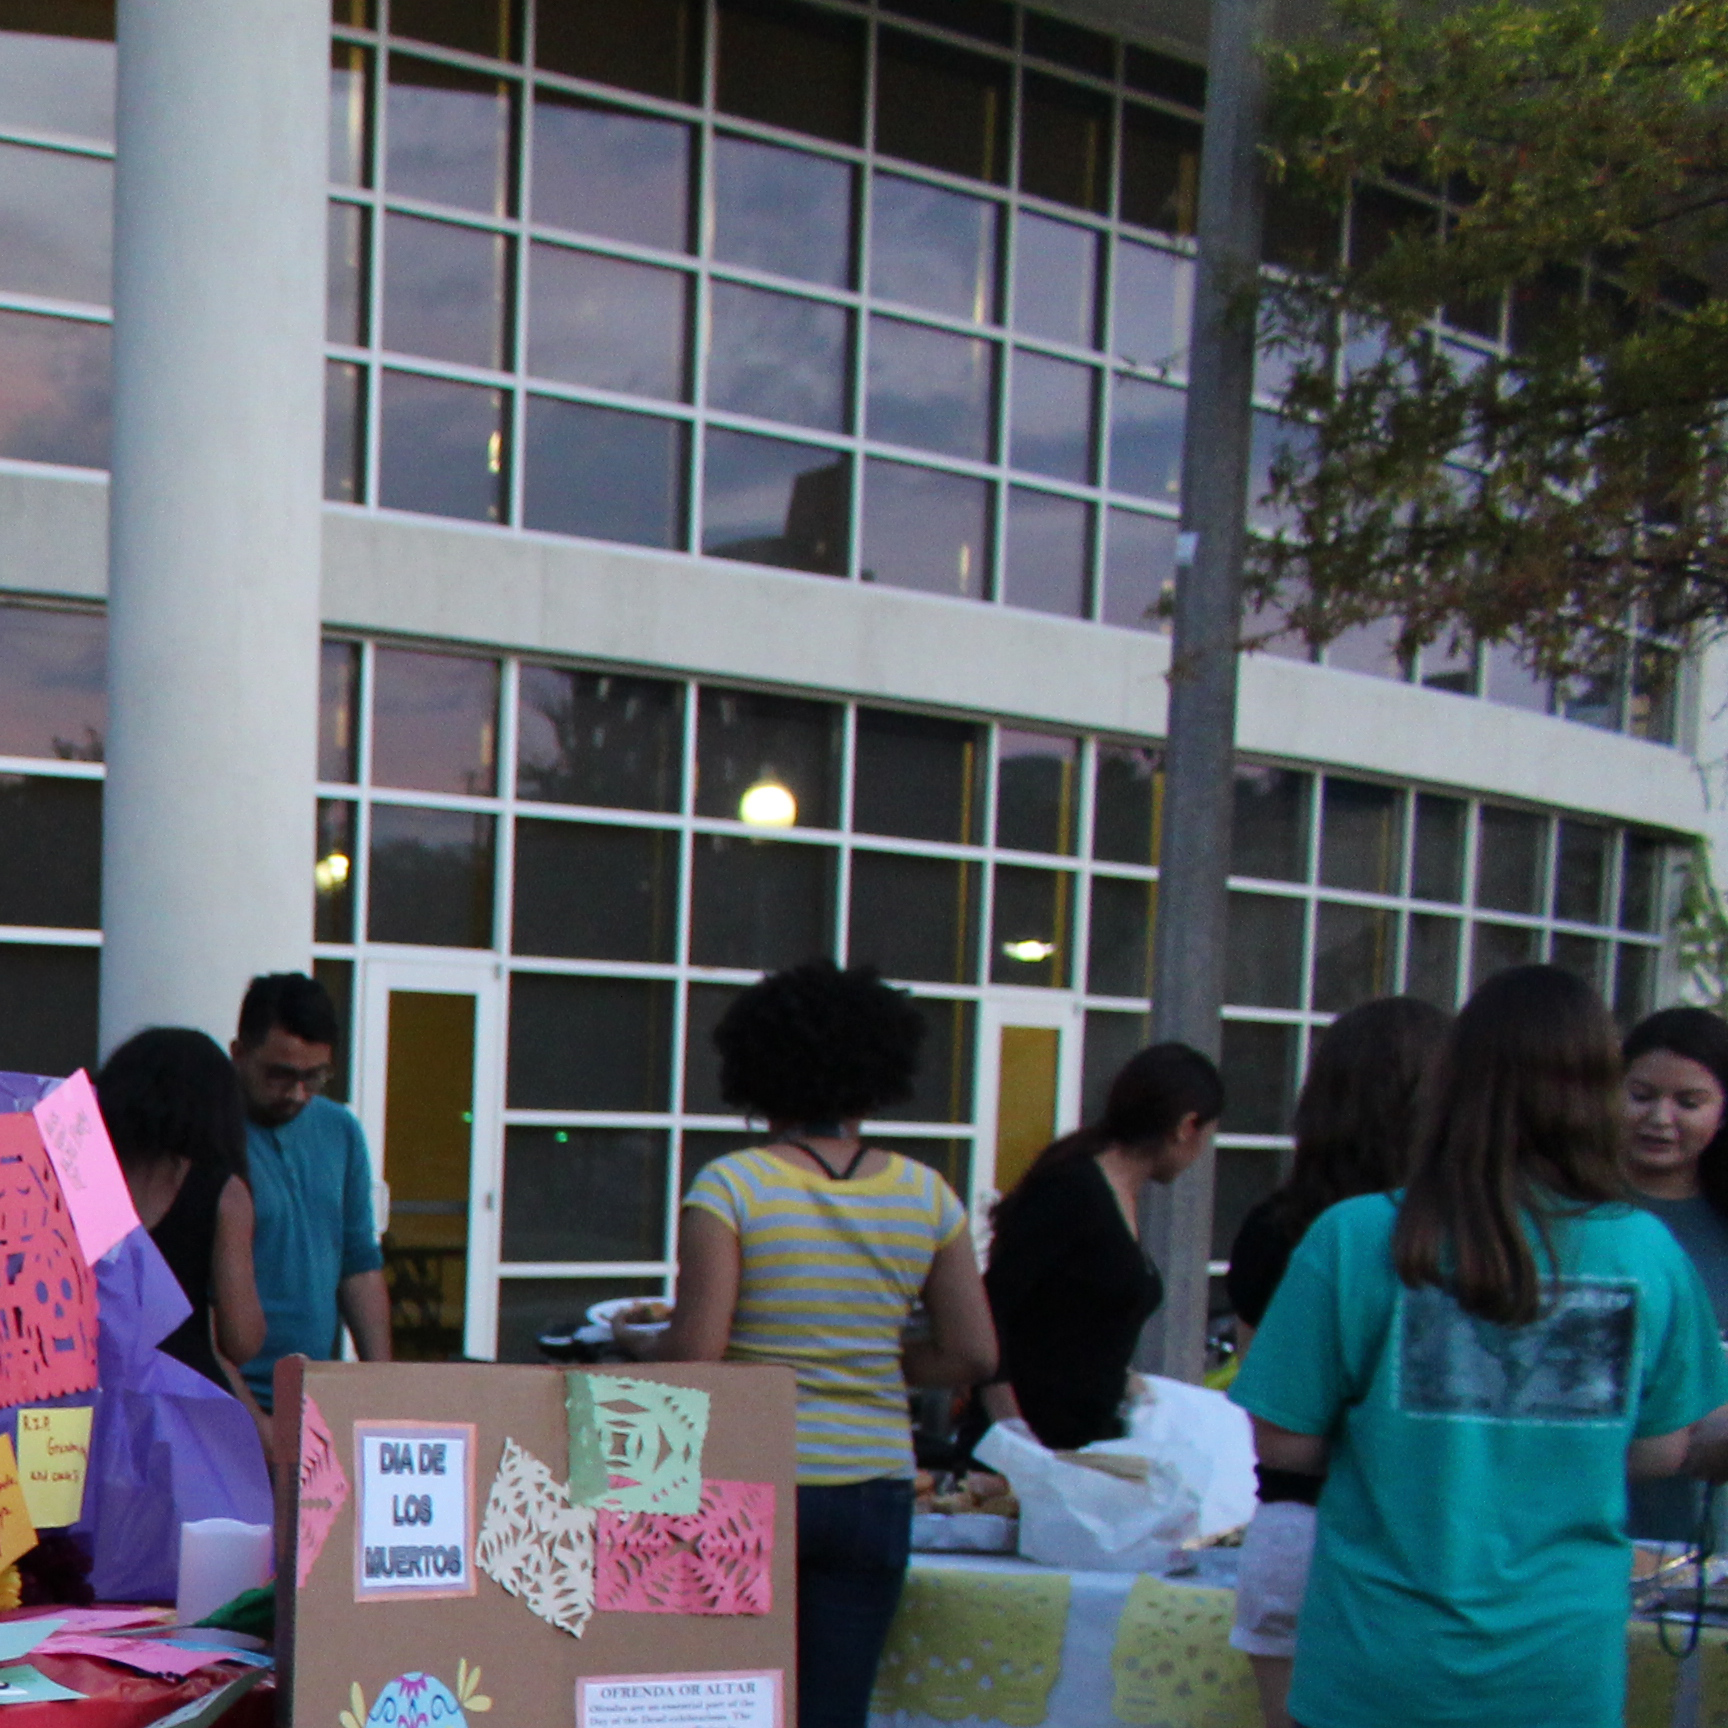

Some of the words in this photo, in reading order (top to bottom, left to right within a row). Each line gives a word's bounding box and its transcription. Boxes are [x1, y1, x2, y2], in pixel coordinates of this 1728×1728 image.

[378, 1442, 416, 1475] DIA
[418, 1443, 447, 1475] DE
[392, 1494, 433, 1527] LOS
[364, 1545, 463, 1579] MUERTOS
[600, 1684, 675, 1700] OFRENDA
[678, 1682, 702, 1697] OR
[706, 1681, 758, 1697] ALTAR
